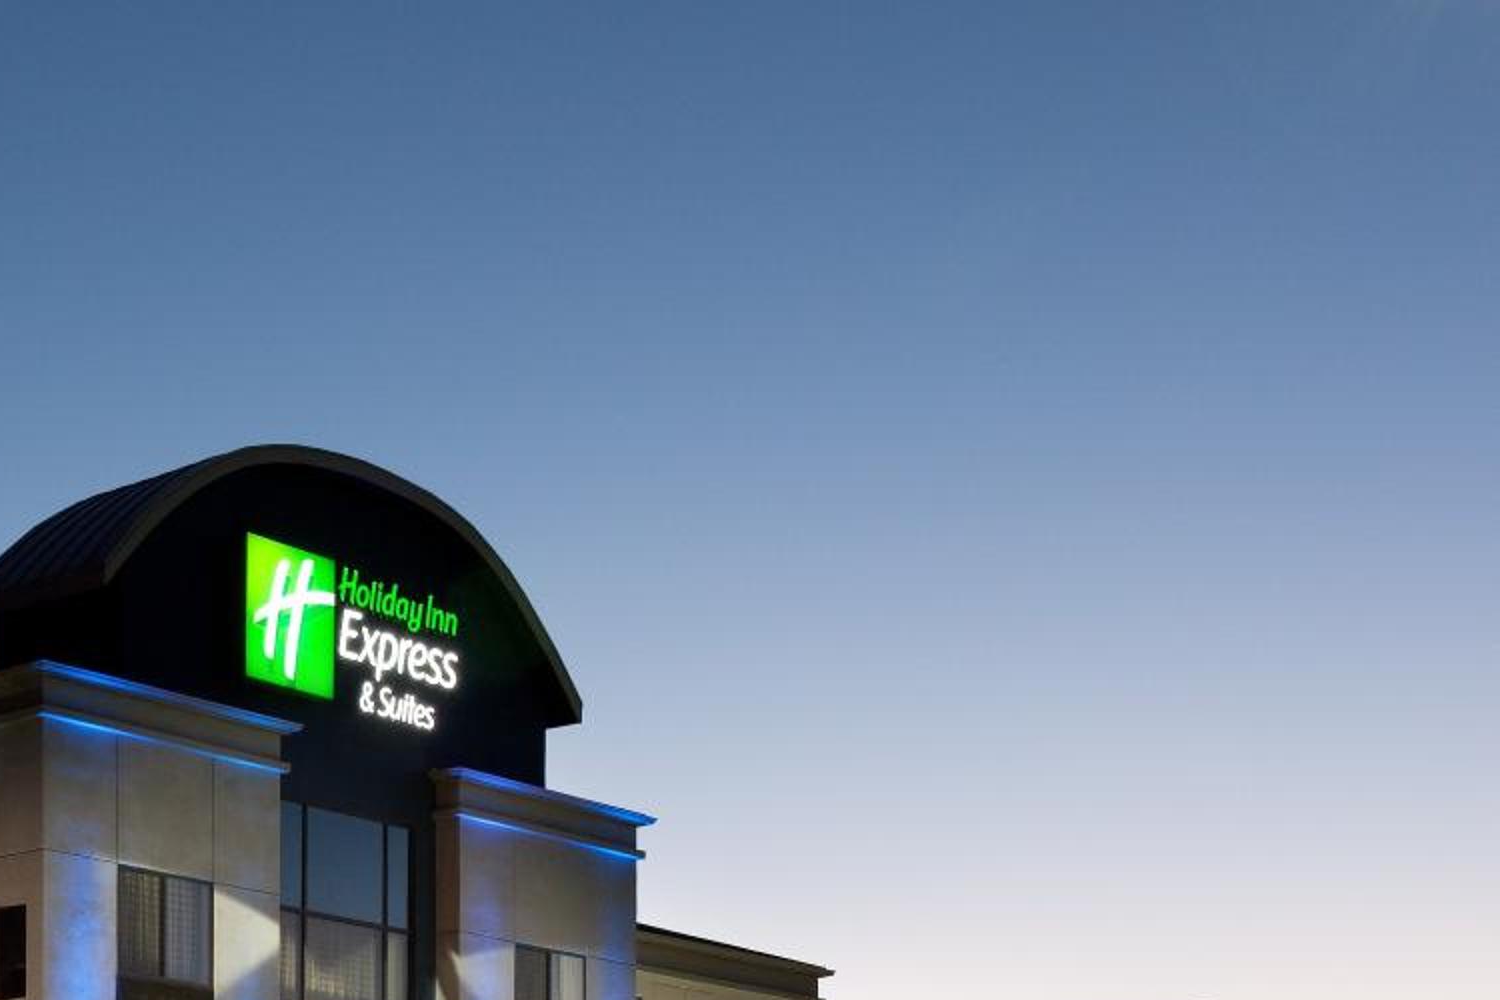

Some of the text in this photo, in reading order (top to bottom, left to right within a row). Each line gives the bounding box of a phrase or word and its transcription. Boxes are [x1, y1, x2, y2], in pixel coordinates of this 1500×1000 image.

[338, 566, 458, 636] Holiday Inn
[339, 608, 459, 689] Express
[360, 682, 436, 731] & Suites
